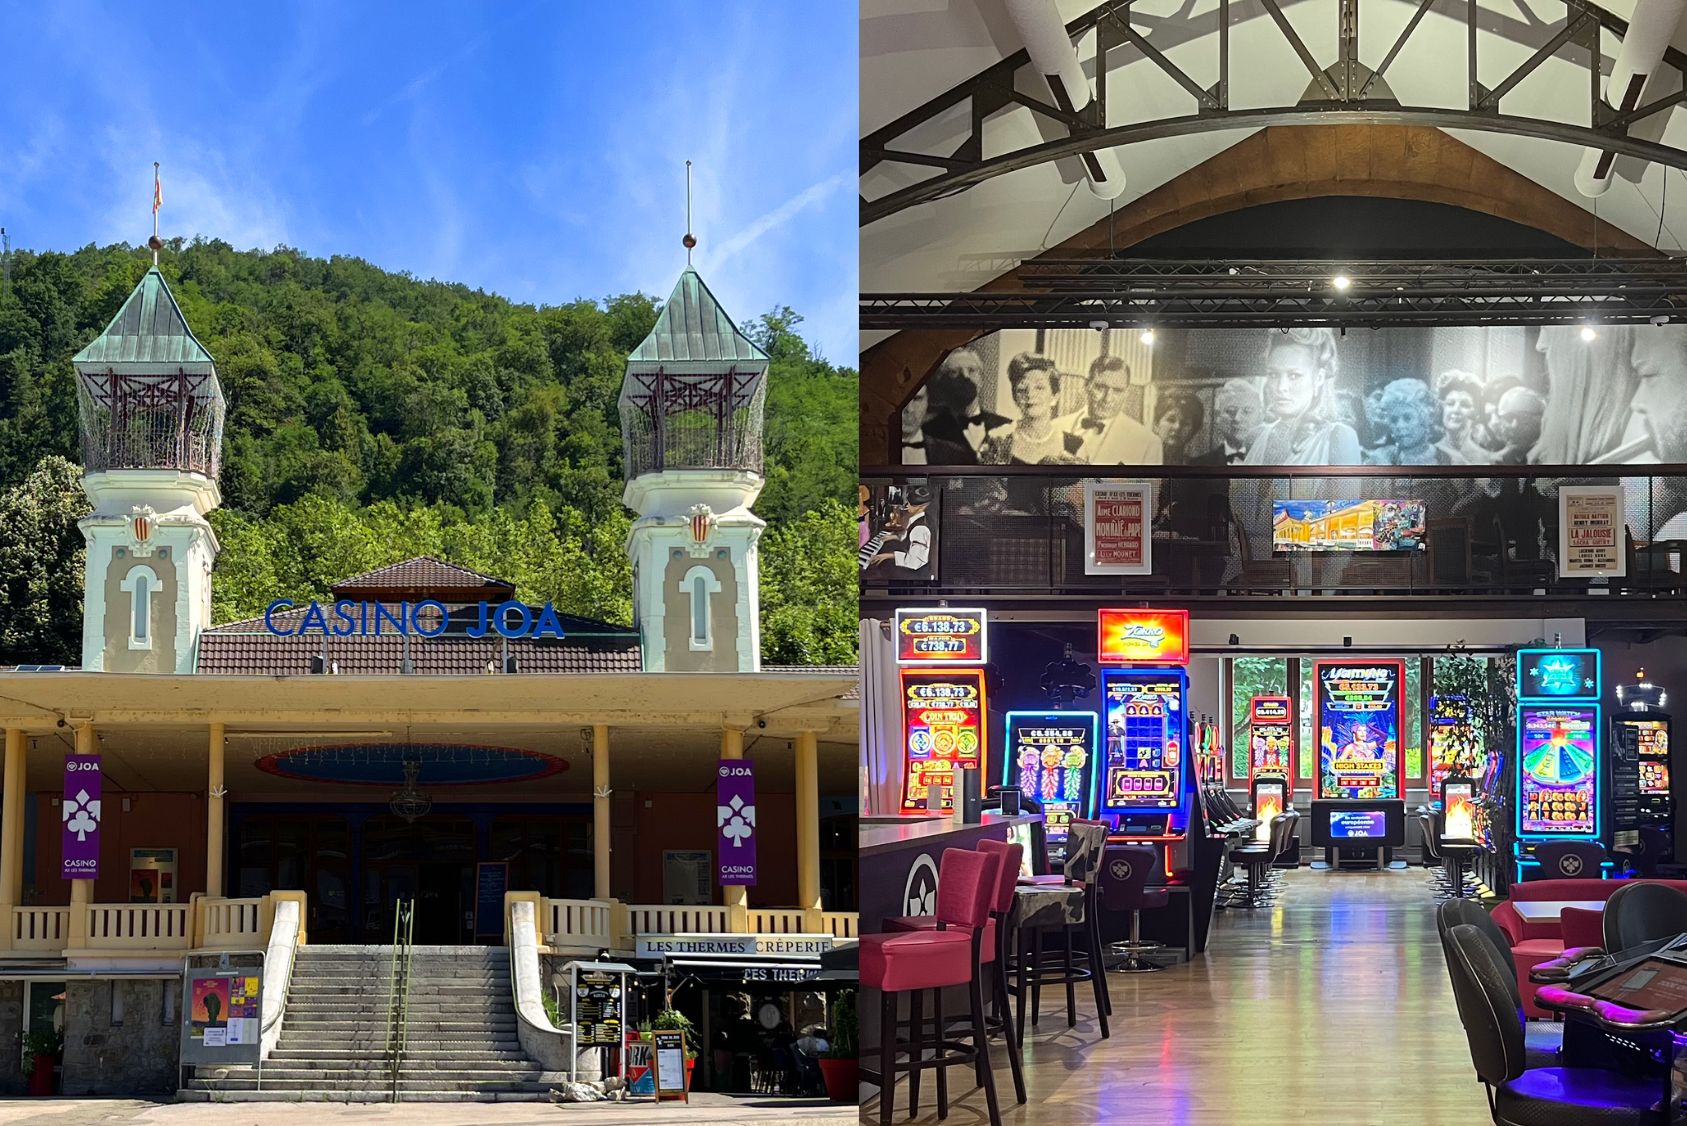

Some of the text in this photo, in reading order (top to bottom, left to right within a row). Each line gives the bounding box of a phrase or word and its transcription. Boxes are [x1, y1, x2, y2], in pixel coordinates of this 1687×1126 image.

[1571, 529, 1612, 538] LA JALOUSIE
[264, 598, 566, 639] CASINO JOA
[914, 621, 966, 633] €6.138,73
[921, 641, 959, 651] €738,77
[78, 762, 100, 771] JOA
[730, 767, 752, 776] JOA
[64, 859, 97, 867] CASINO
[721, 865, 754, 873] CASINO
[647, 941, 673, 952] LES
[676, 941, 745, 953] THERMES
